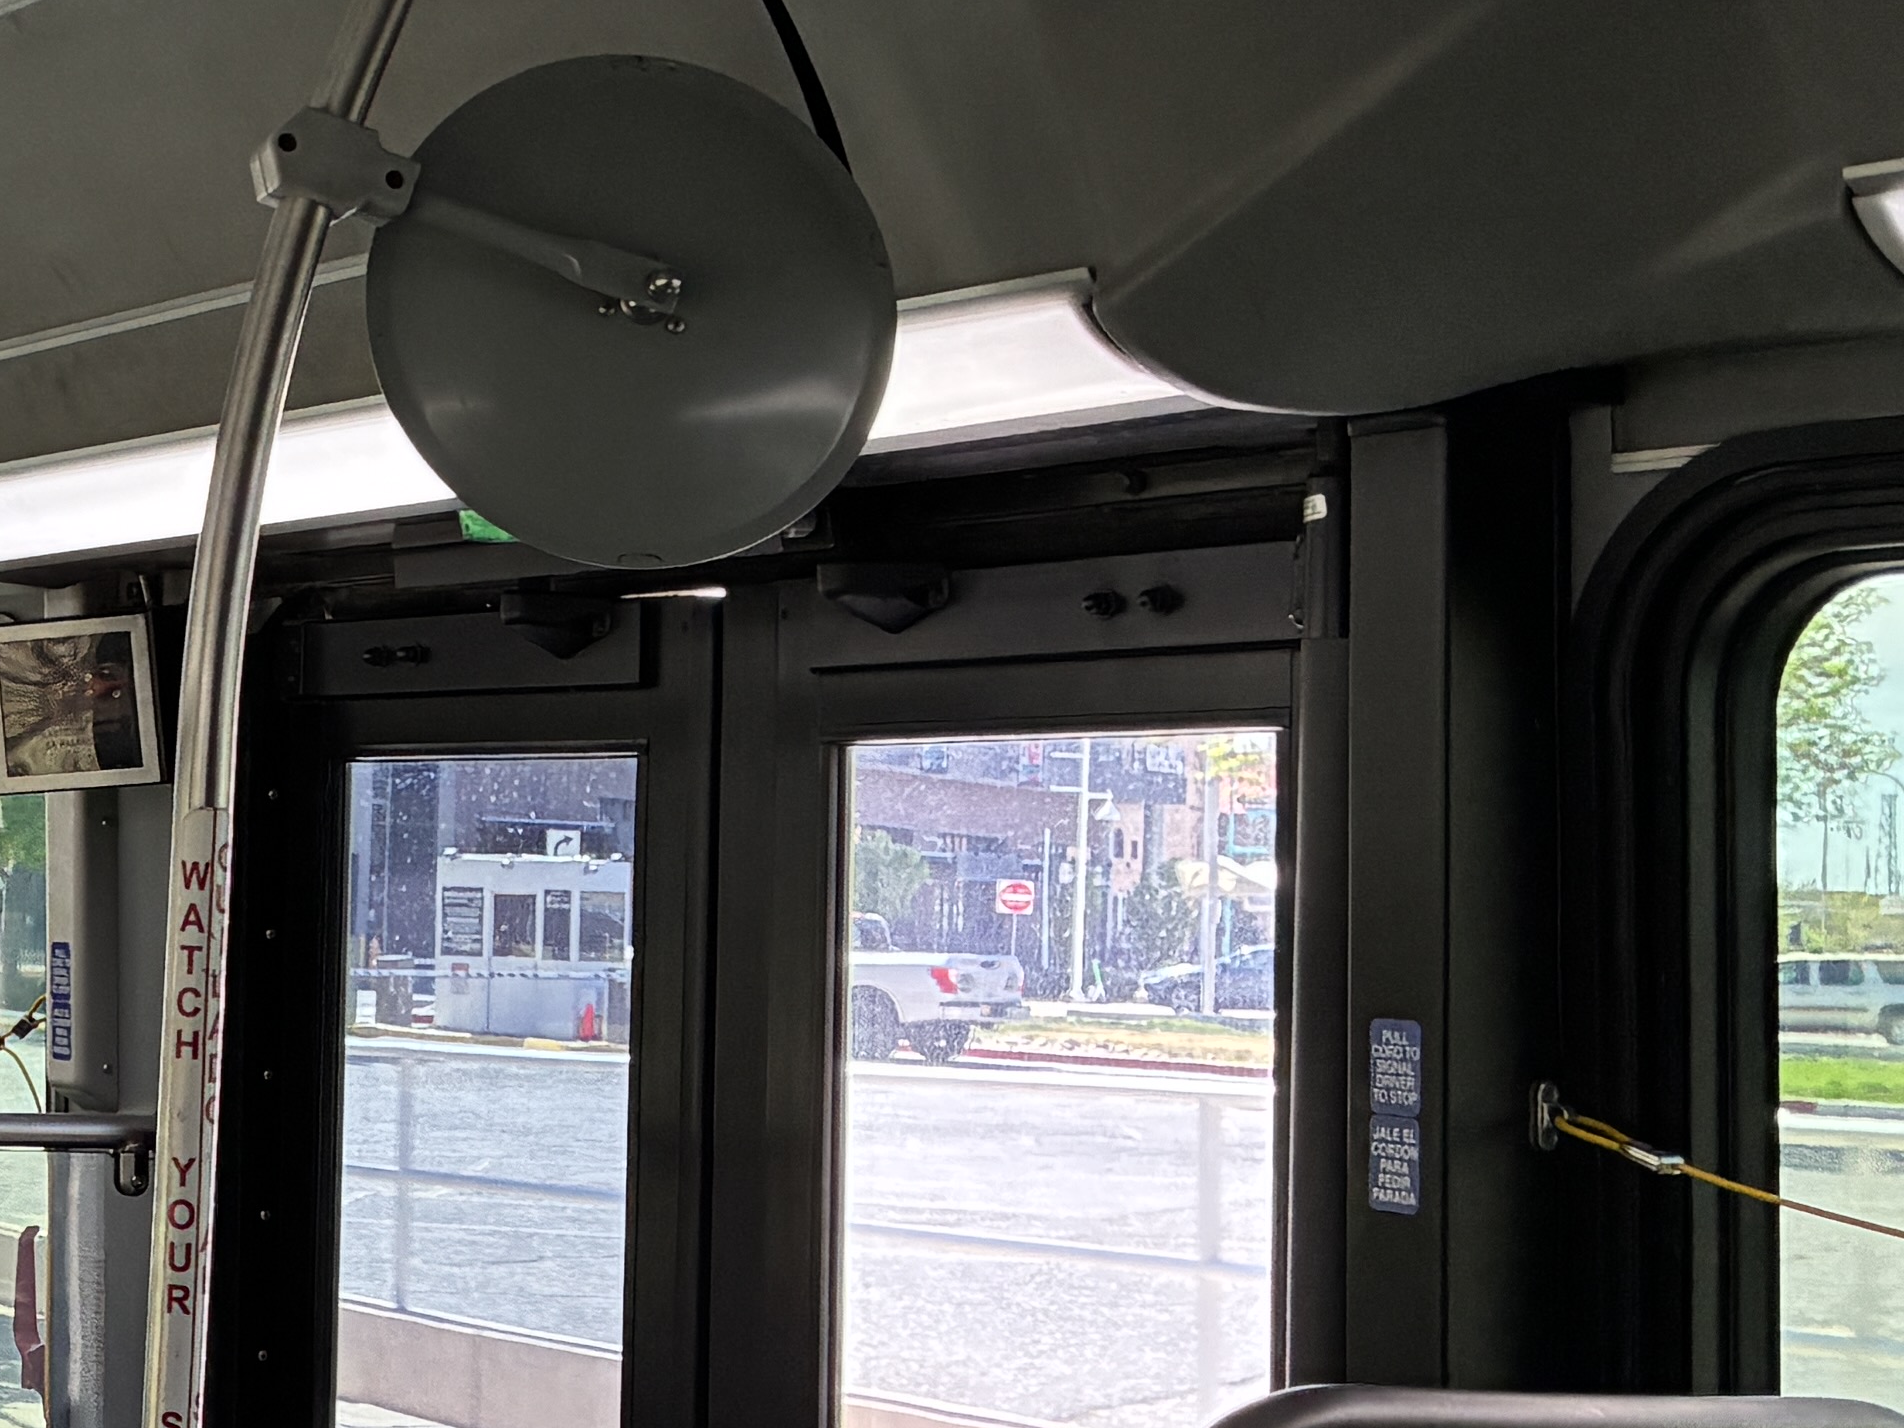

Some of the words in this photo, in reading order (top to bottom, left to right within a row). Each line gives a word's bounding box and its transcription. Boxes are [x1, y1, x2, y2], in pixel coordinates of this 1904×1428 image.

[175, 860, 210, 1060] WATCH
[1381, 1029, 1409, 1045] PULL
[1405, 1046, 1420, 1060] TO
[1389, 1090, 1418, 1105] STOP
[1373, 1126, 1400, 1141] JALE
[1403, 1128, 1416, 1143] EL
[1380, 1158, 1409, 1174] PARA
[1378, 1174, 1410, 1188] PEDIR
[1372, 1188, 1416, 1206] PARADA
[166, 1157, 196, 1315] YOUR
